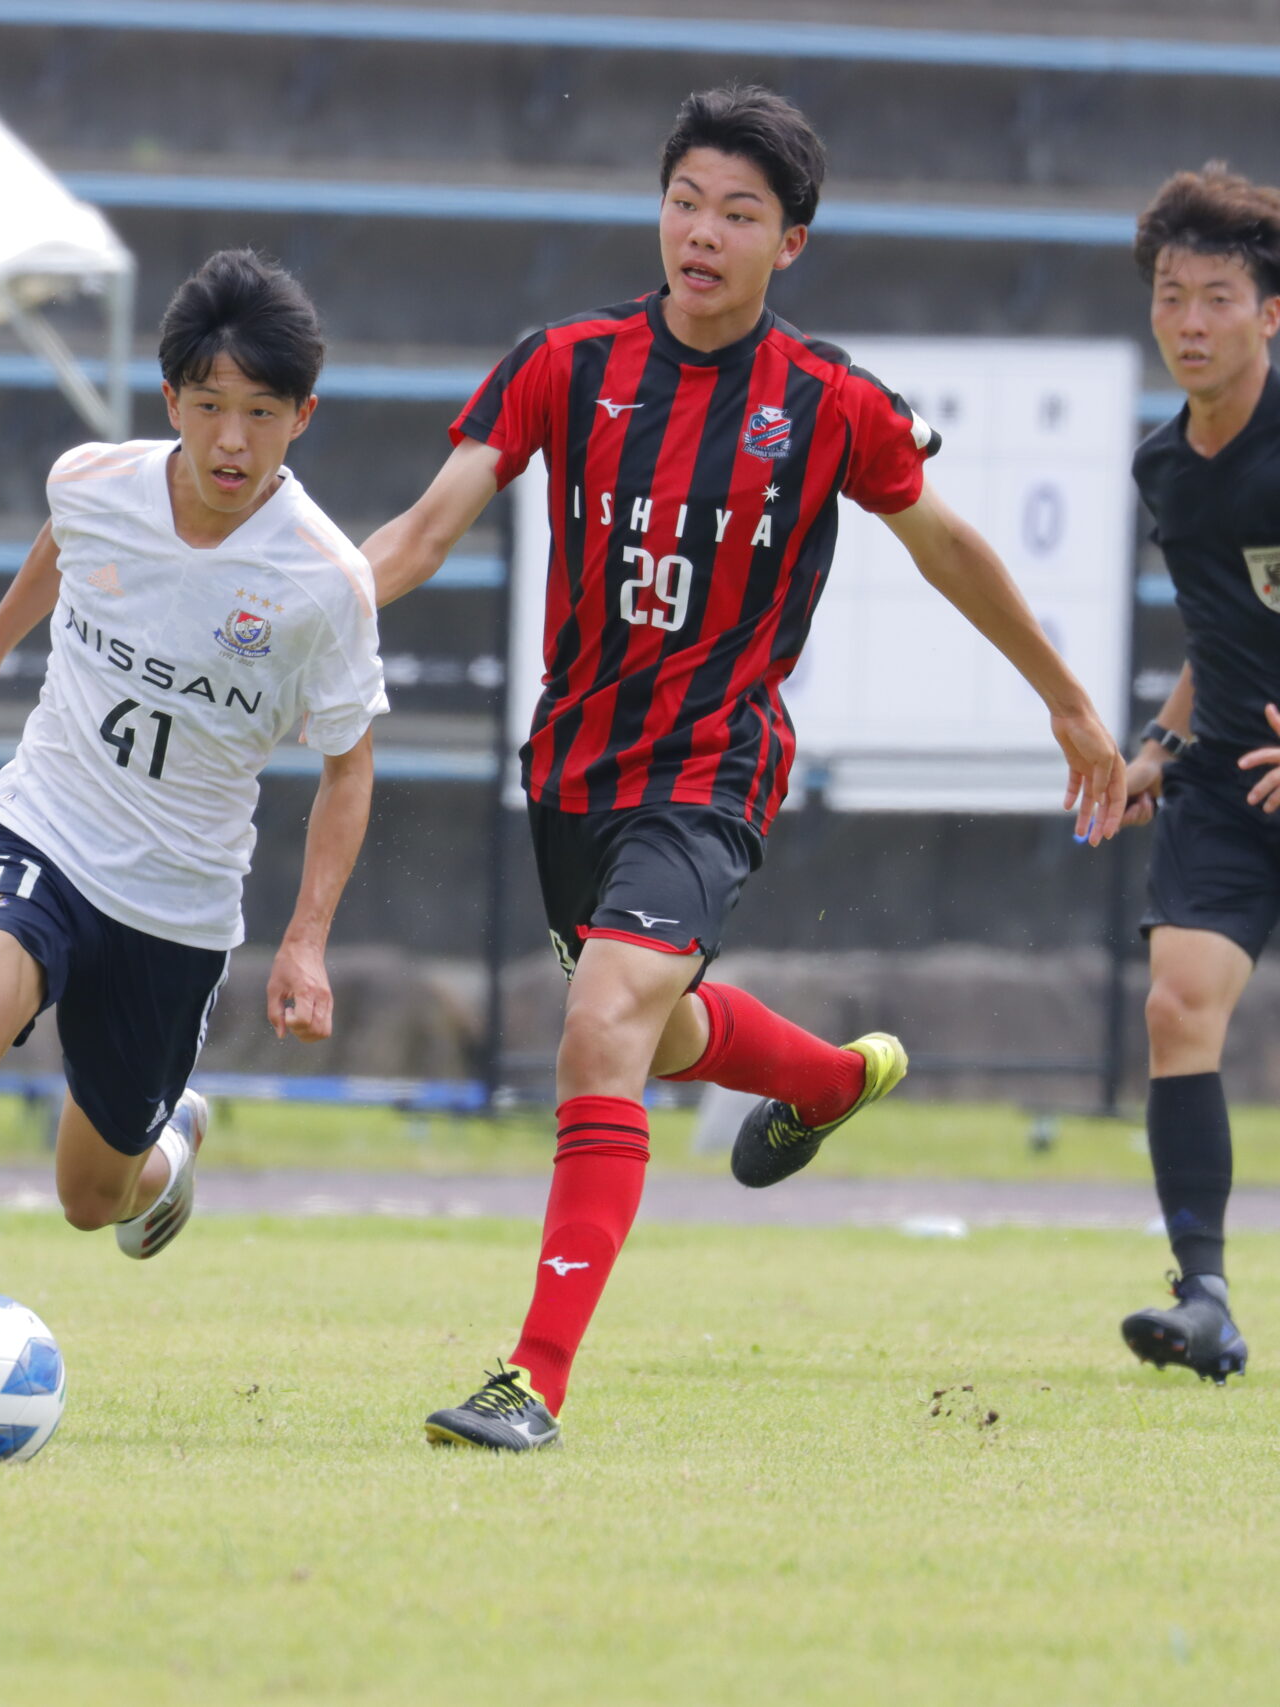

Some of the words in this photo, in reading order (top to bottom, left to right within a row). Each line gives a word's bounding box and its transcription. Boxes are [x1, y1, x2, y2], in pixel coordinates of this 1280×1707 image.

[573, 484, 772, 548] ISHIYA
[620, 545, 694, 632] 29
[65, 606, 262, 714] NISSAN
[99, 698, 173, 780] 41
